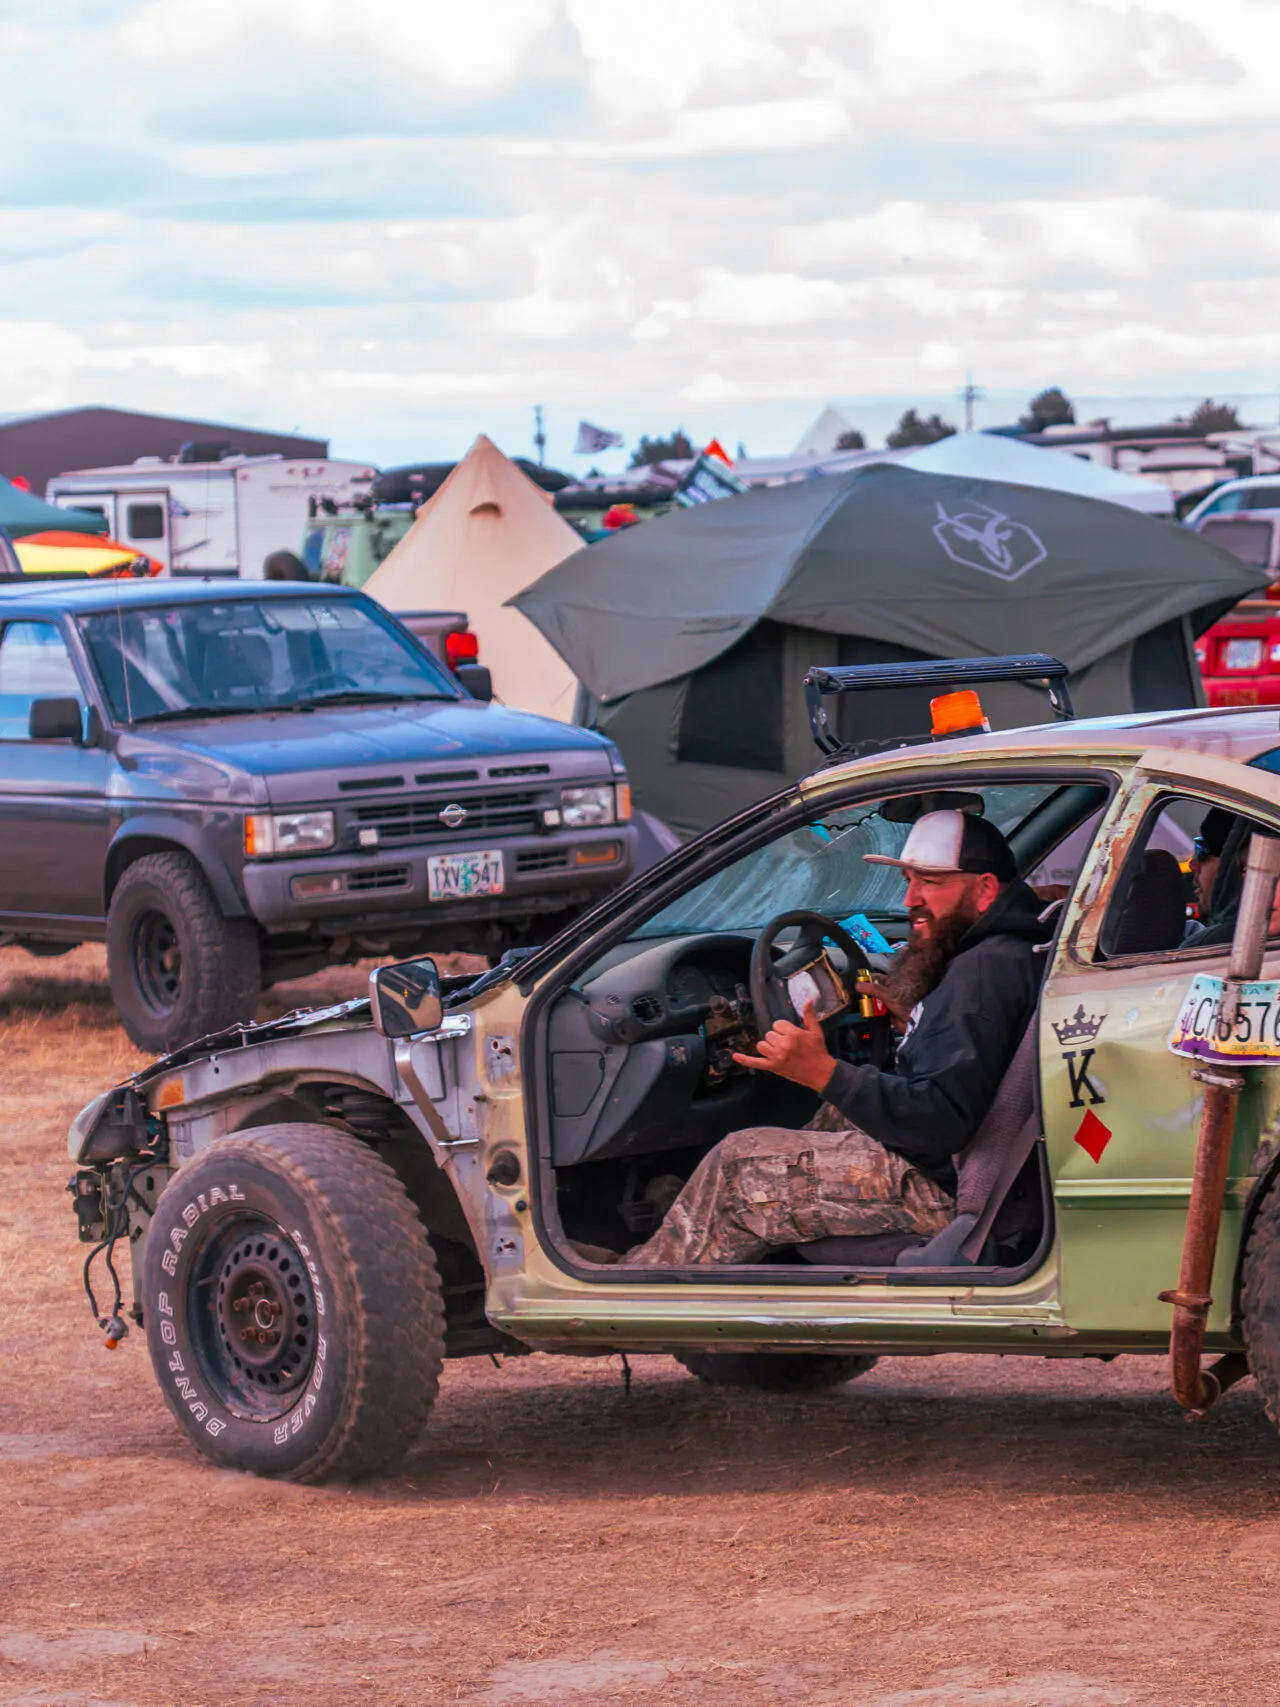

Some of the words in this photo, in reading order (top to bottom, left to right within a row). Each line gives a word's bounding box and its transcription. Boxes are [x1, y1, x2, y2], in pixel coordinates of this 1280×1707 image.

[470, 861, 500, 885] 547
[1062, 1048, 1106, 1108] K
[161, 1185, 246, 1277] RADIAL
[159, 1291, 227, 1437] DUNLOP
[274, 1335, 328, 1445] ROVER
